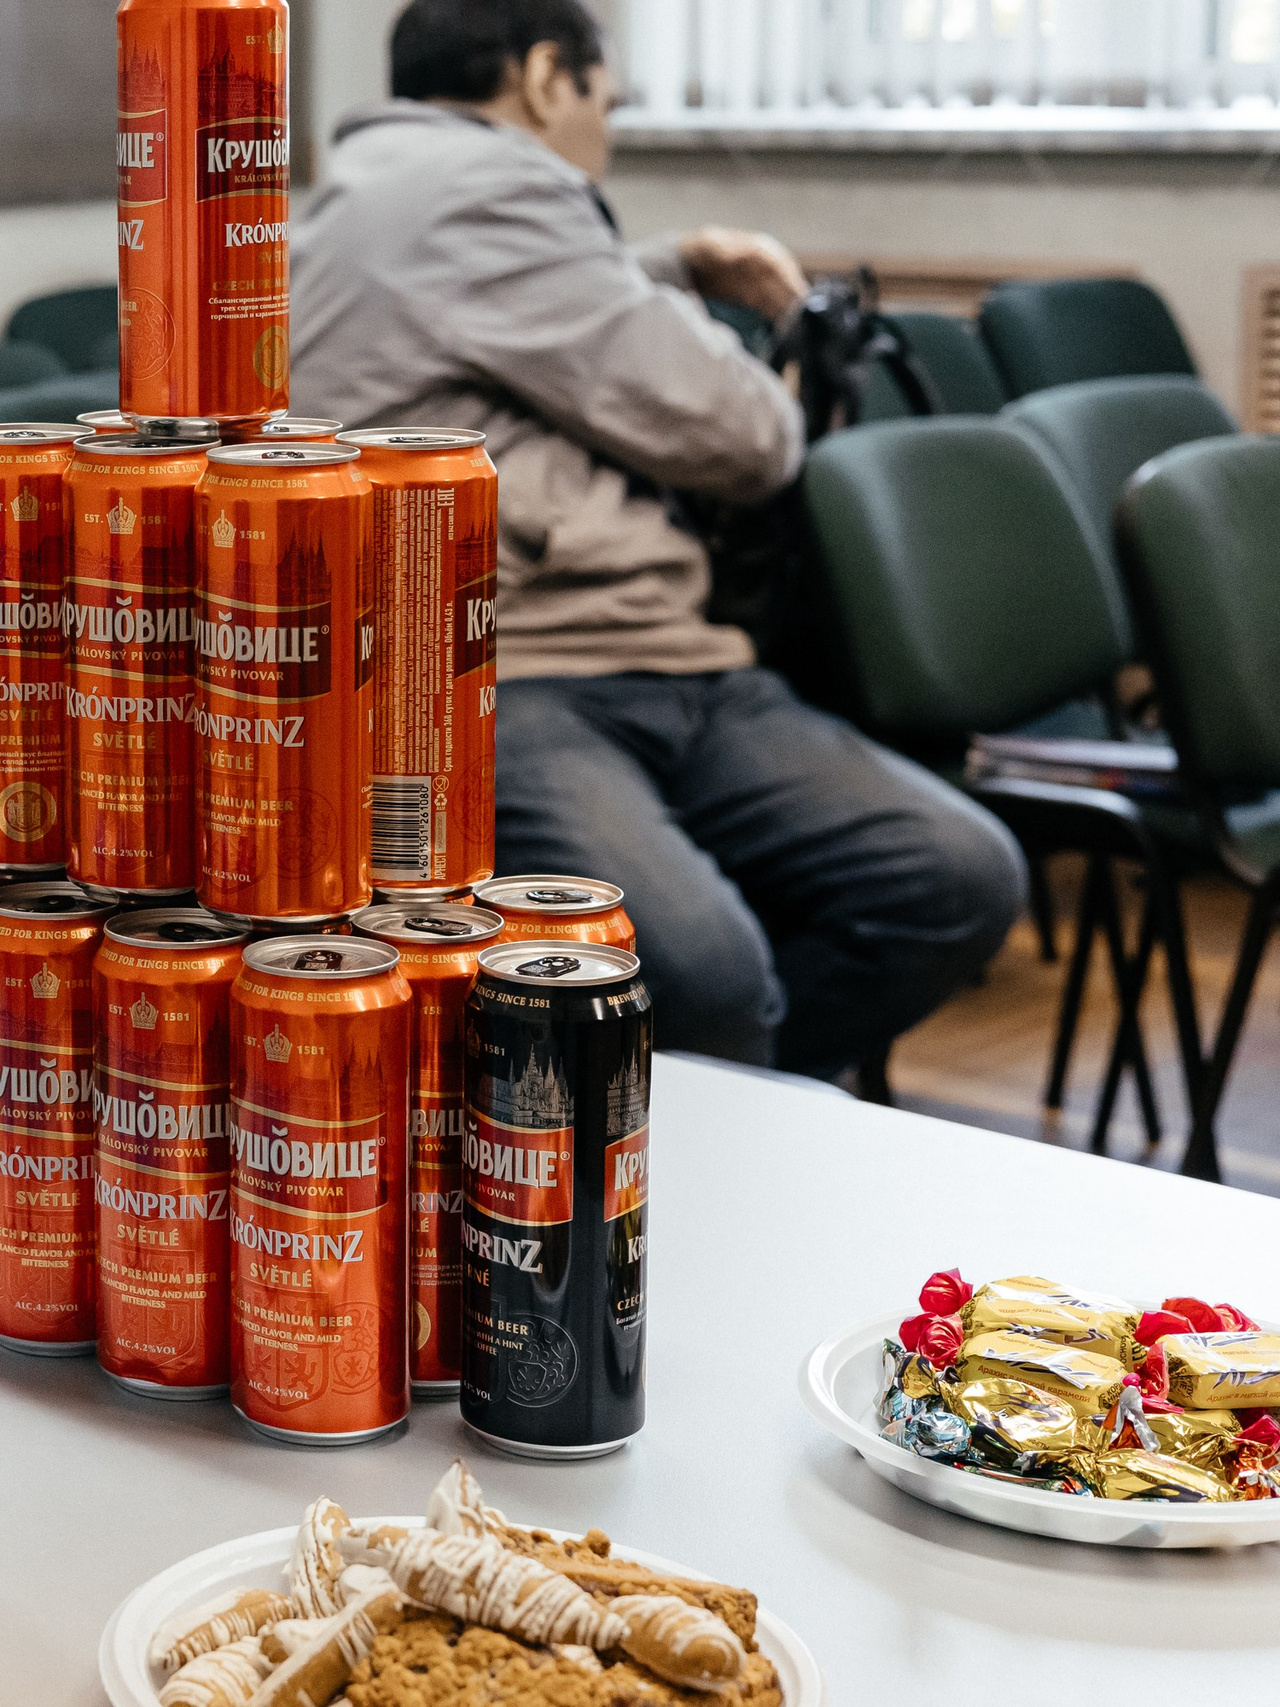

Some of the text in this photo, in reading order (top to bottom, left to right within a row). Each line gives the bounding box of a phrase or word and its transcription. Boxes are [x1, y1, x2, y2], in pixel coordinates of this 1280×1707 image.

[16, 453, 47, 464] KINGS
[93, 463, 200, 475] FOR KINGS SINCE 1581
[220, 476, 308, 489] KINGS SINCE 1581
[85, 513, 167, 525] EST. 1581
[239, 530, 266, 540] 1581
[131, 650, 185, 661] PIVOVAR
[230, 669, 284, 681] PIVOVAR
[443, 608, 454, 772] Срок годности суток даты розлива. Объём 0,43
[66, 686, 196, 723] KRÓNPRINZ
[0, 705, 54, 722] SVĚTLÉ
[0, 734, 61, 746] PREMIUM
[93, 730, 157, 750] SVĚTLÉ
[203, 749, 255, 771] SVĚTLÉ
[106, 792, 137, 801] FLAVOR
[98, 802, 144, 812] BITTERNESS
[260, 798, 294, 812] BEER
[419, 786, 428, 824] 261080
[237, 815, 281, 827] AND MILD
[419, 830, 428, 867] 601501
[13, 928, 32, 939] FOR
[34, 930, 68, 940] KINGS
[521, 922, 607, 934] FOR KINGS SINCE
[118, 954, 225, 970] FOR KINGS SINCE 1581
[432, 954, 463, 964] SINCE
[5, 977, 27, 988] EST.
[252, 985, 365, 1002] FOR KINGS SINCE 1581
[474, 985, 551, 1009] KINGS SINCE 1581
[607, 990, 637, 1006] BREWED
[109, 1003, 190, 1022] EST. 1581
[243, 1035, 325, 1056] EST. 1581
[484, 1044, 505, 1057] 1581
[153, 1146, 209, 1158] PIVOVAR
[16, 1189, 81, 1207] SVĚTLÉ
[94, 1171, 227, 1222] KRÓNPRINZ
[286, 1184, 345, 1198] PIVOVAR
[21, 1231, 83, 1244] PREMIUM
[116, 1223, 180, 1248] SVĚTLÉ
[231, 1205, 365, 1264] KRÓNPRINZ
[30, 1249, 63, 1258] FLAVOR
[64, 1249, 84, 1258] AND
[21, 1258, 69, 1268] BITTERNESS
[121, 1266, 217, 1285] PREMIUM BEER
[249, 1262, 313, 1289] SVĚTLÉ
[130, 1285, 207, 1300] FLAVOR AND MILD
[121, 1294, 166, 1308] BITTERNESS
[254, 1306, 354, 1328] PREMIUM BEER
[498, 1320, 528, 1336] BEER
[261, 1327, 342, 1344] FLAVOR AND MILD
[253, 1334, 299, 1352] BITTERNESS
[502, 1340, 523, 1350] HINT
[978, 1364, 1008, 1380] Арахис
[1018, 1377, 1046, 1390] мягкой
[1047, 1386, 1090, 1403] карамели
[476, 1388, 492, 1401] VOL
